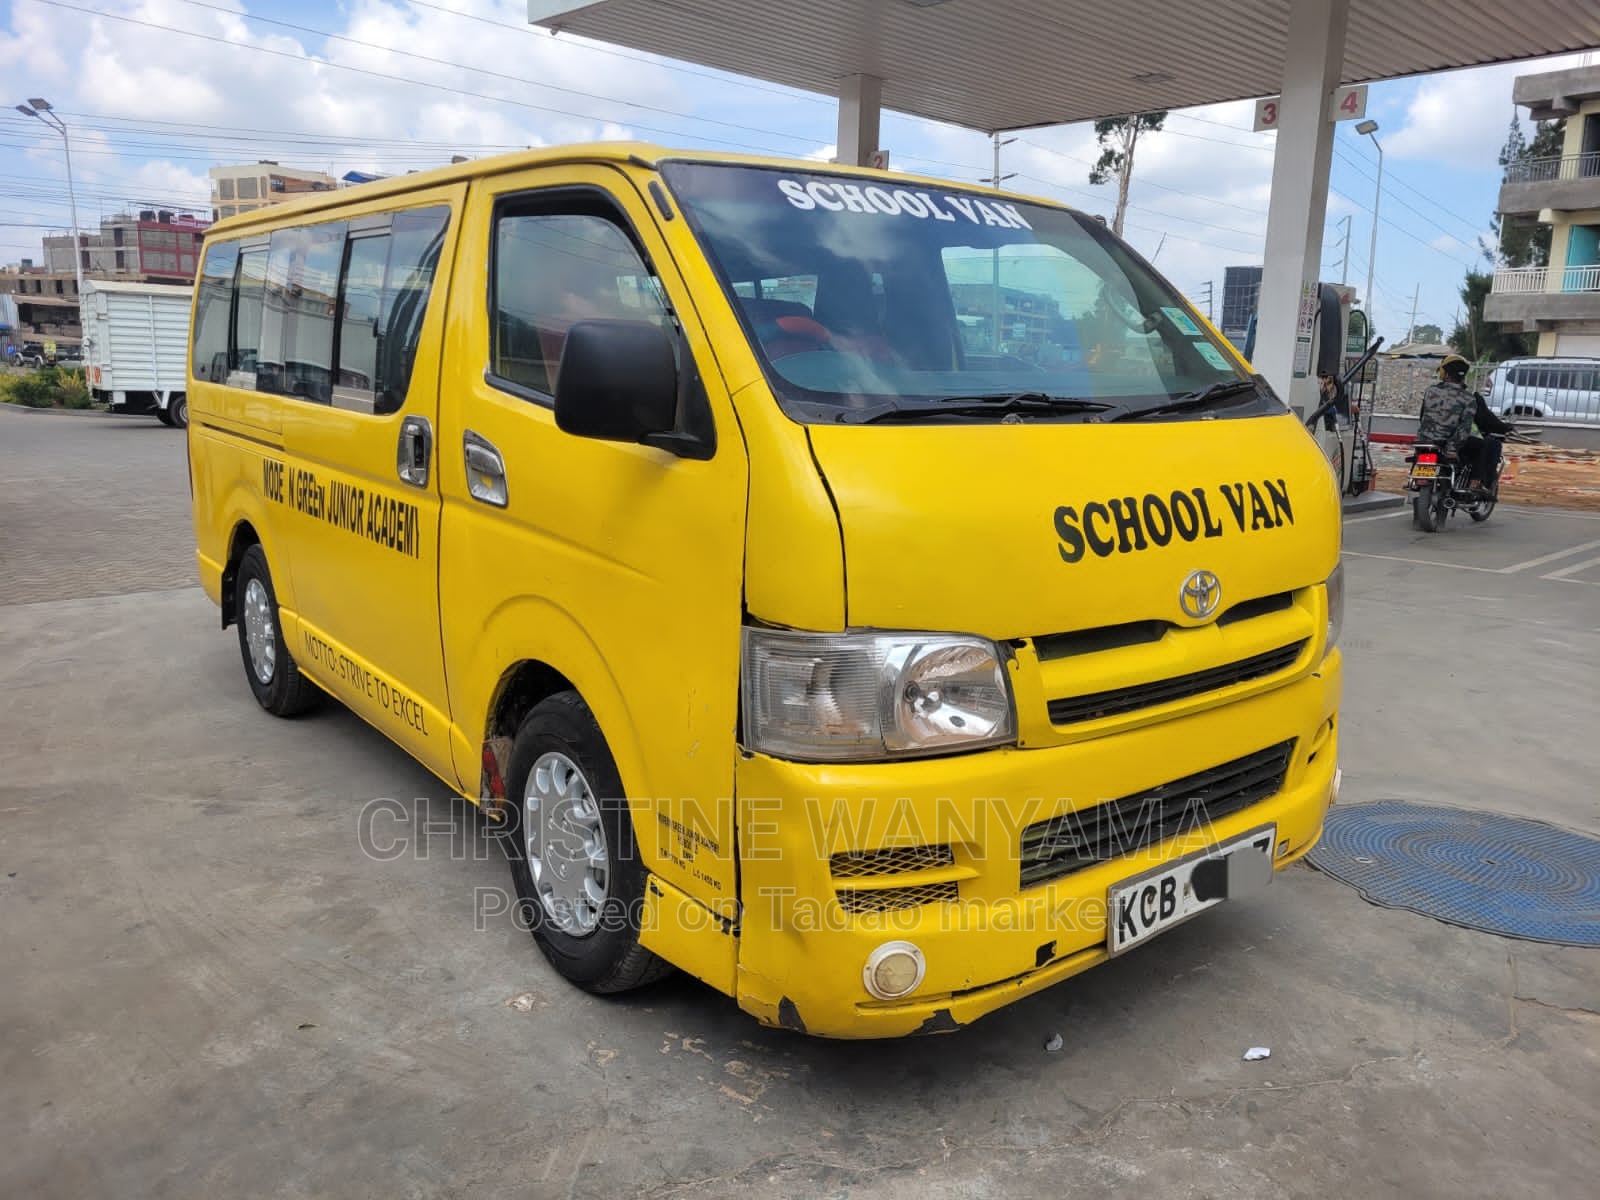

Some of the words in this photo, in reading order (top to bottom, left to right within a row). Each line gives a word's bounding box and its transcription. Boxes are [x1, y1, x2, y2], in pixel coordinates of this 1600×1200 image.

[1262, 102, 1277, 125] 3
[1340, 91, 1358, 113] 4
[777, 179, 955, 222] SCHOOL
[943, 196, 1033, 231] VAN
[327, 479, 365, 537] JUNIOR
[1053, 487, 1223, 564] SCHOOL
[1219, 479, 1294, 533] VAN
[339, 654, 373, 699] STRIVE
[374, 677, 390, 709] TO
[392, 687, 429, 736] EXCEL
[1117, 875, 1177, 944] KCB
